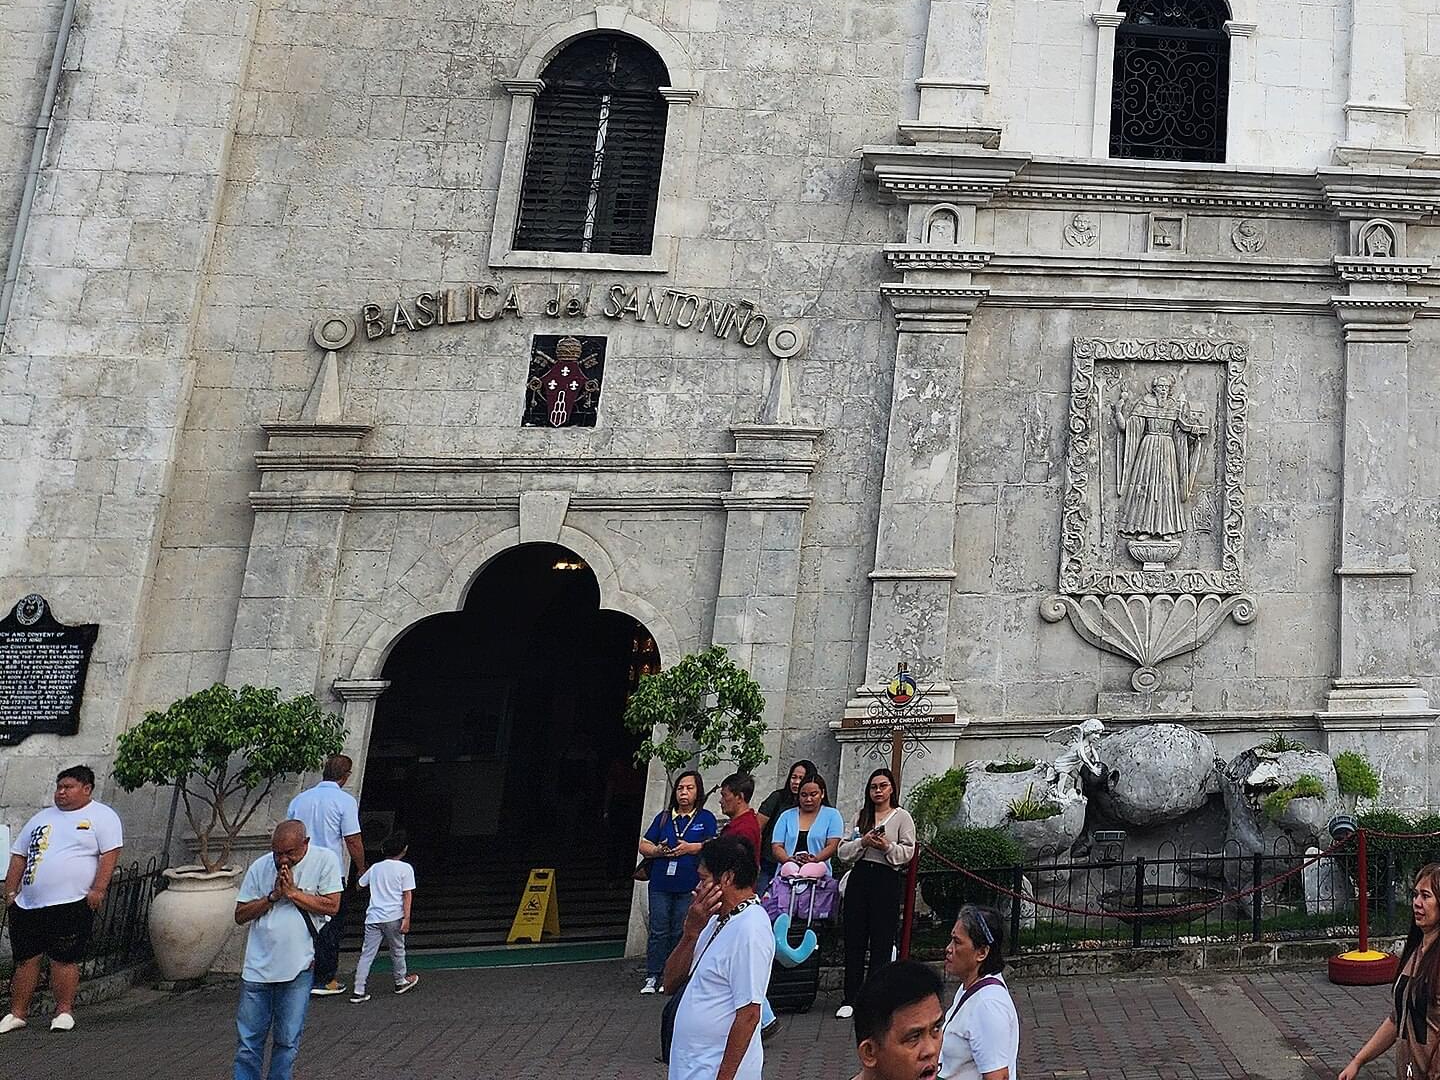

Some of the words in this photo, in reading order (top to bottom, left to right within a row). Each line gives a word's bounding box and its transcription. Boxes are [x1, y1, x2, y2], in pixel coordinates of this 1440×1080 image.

[363, 284, 521, 340] BASILICA
[546, 282, 593, 318] del
[603, 284, 700, 329] SANTO
[699, 298, 768, 347] NIÑO
